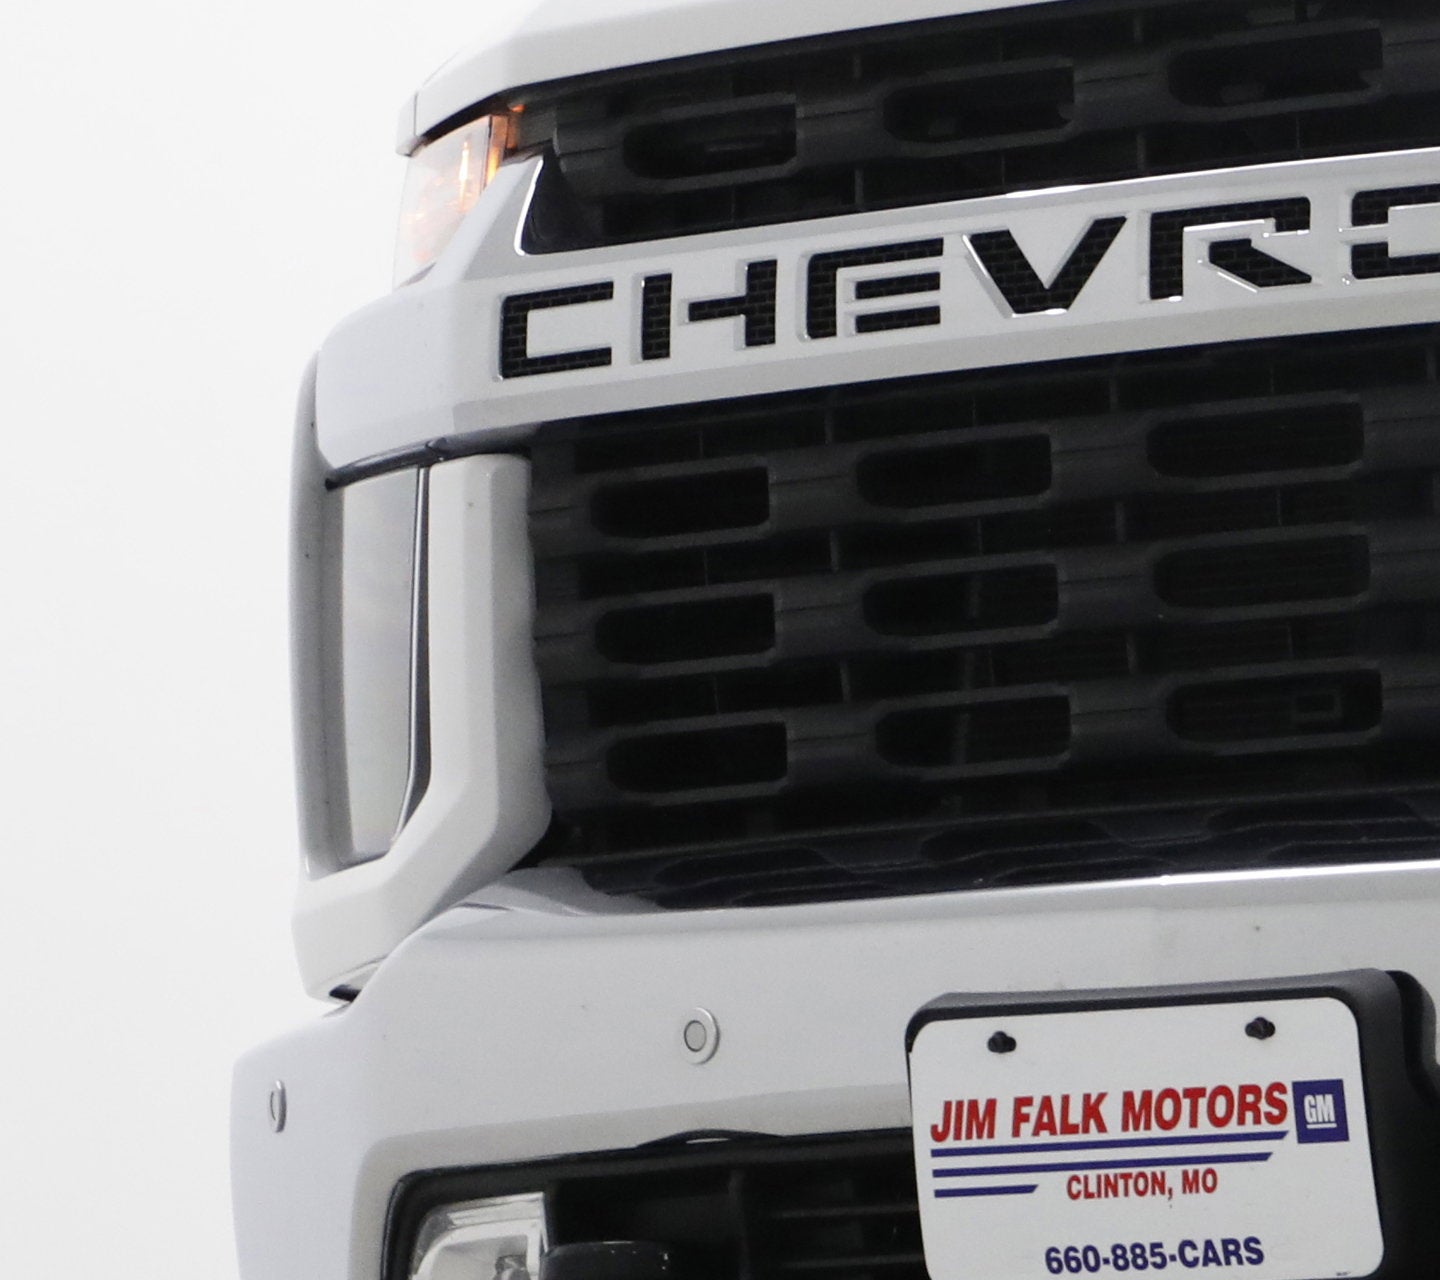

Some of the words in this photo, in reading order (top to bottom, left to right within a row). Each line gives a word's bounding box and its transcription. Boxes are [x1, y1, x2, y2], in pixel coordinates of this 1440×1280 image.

[930, 1097, 997, 1144] JIM
[1012, 1091, 1108, 1137] FALK
[1122, 1081, 1289, 1131] MOTORS
[1304, 1095, 1337, 1124] GM
[1066, 1170, 1174, 1201] CLINTON,
[1182, 1168, 1218, 1194] MO
[1044, 1237, 1265, 1275] 660-885-CARS
